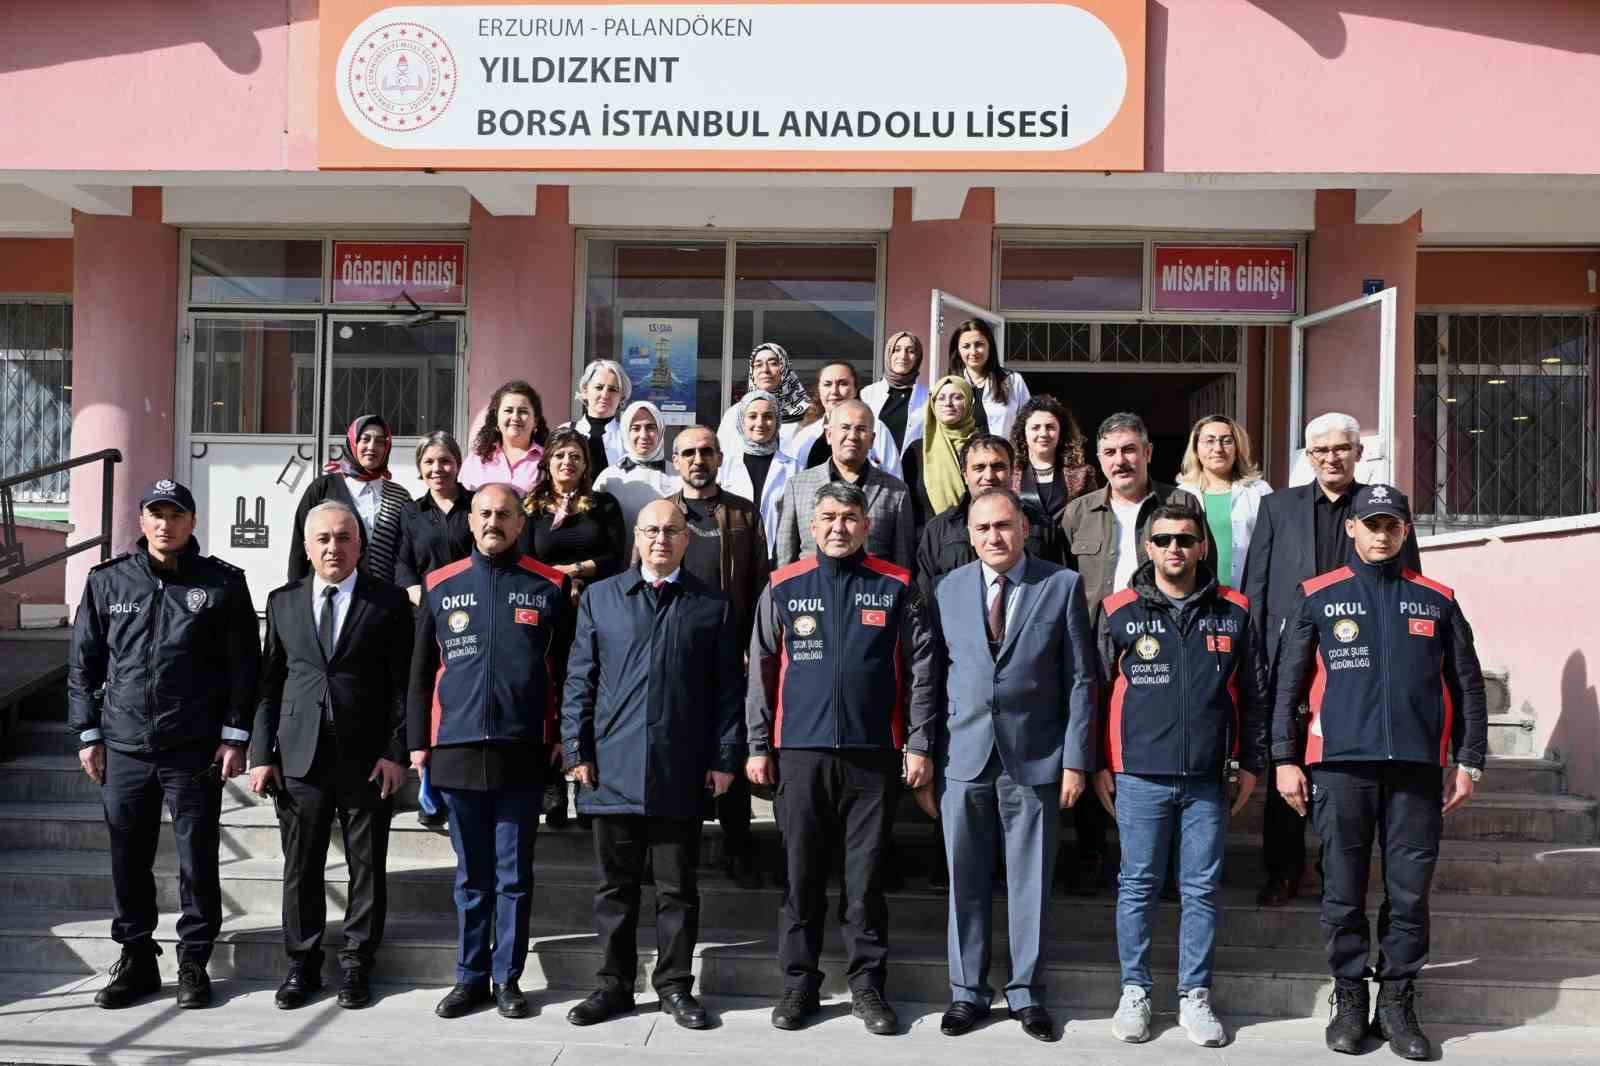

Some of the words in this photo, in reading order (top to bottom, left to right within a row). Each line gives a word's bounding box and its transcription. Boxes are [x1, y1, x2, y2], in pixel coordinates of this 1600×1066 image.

[478, 18, 584, 37] ERZURUM
[604, 14, 753, 37] PALANDÖKEN
[480, 57, 680, 83] YILDIZKENT
[477, 109, 591, 137] BORSA
[602, 104, 769, 138] İSTANBUL
[779, 110, 956, 138] ANADOLU
[966, 104, 1069, 138] LİSESİ
[342, 254, 407, 286] ÖĞRENCİ
[412, 255, 457, 293] GİRİŞİ
[1162, 259, 1231, 292] MİSAFİR
[1236, 259, 1285, 300] GİRİŞİ
[441, 593, 478, 610] OKUL
[788, 598, 825, 612] OKUL
[1324, 602, 1367, 617] OKUL
